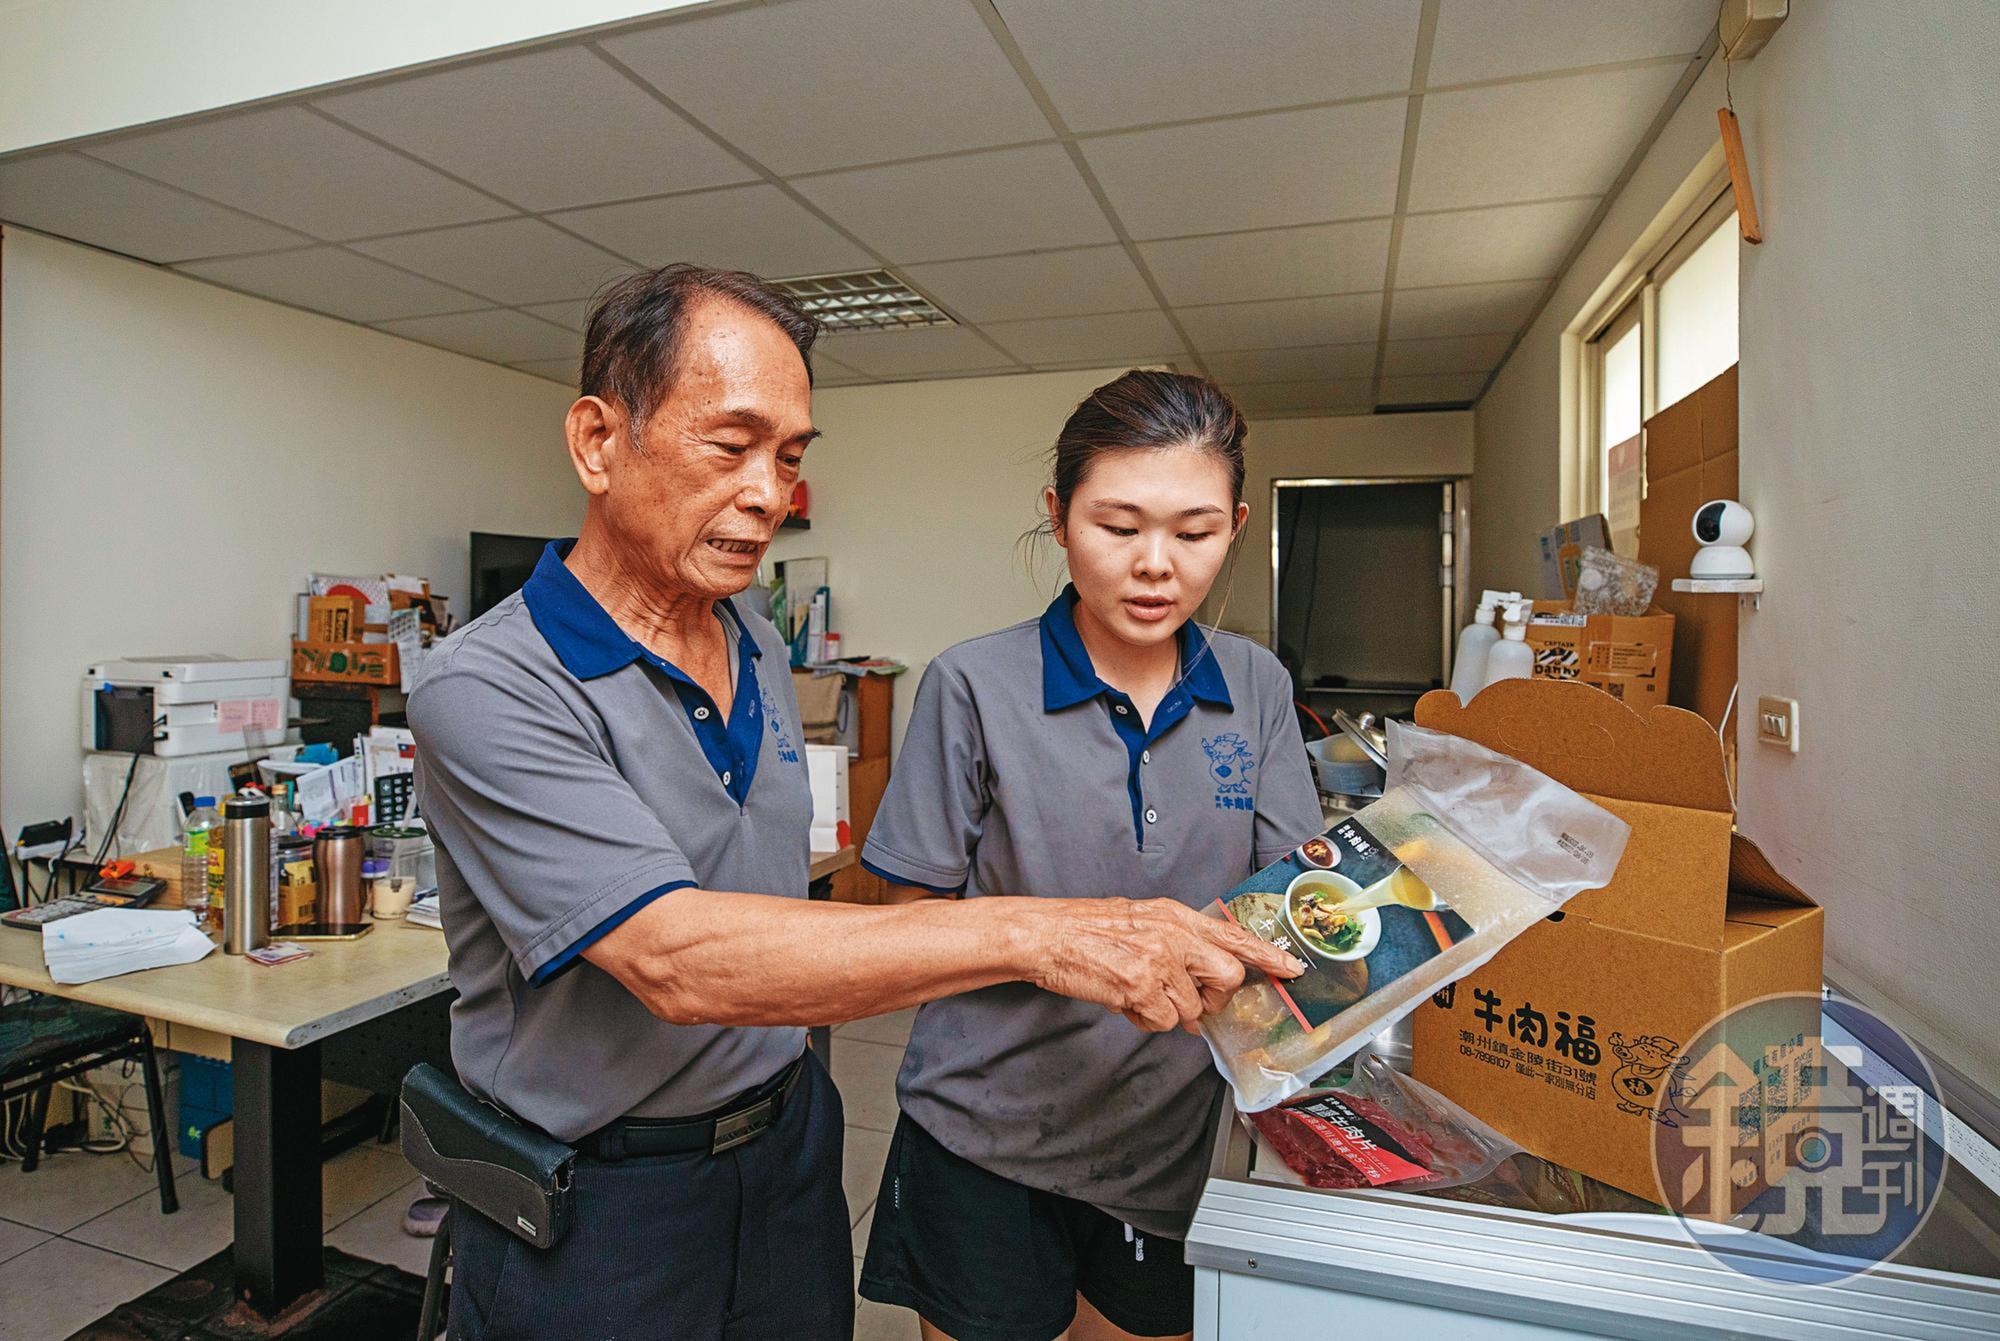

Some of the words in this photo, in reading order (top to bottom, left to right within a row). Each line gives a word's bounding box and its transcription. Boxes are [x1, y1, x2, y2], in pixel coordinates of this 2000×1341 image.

[1534, 663, 1581, 678] Danny
[1473, 987, 1602, 1067] 牛肉福
